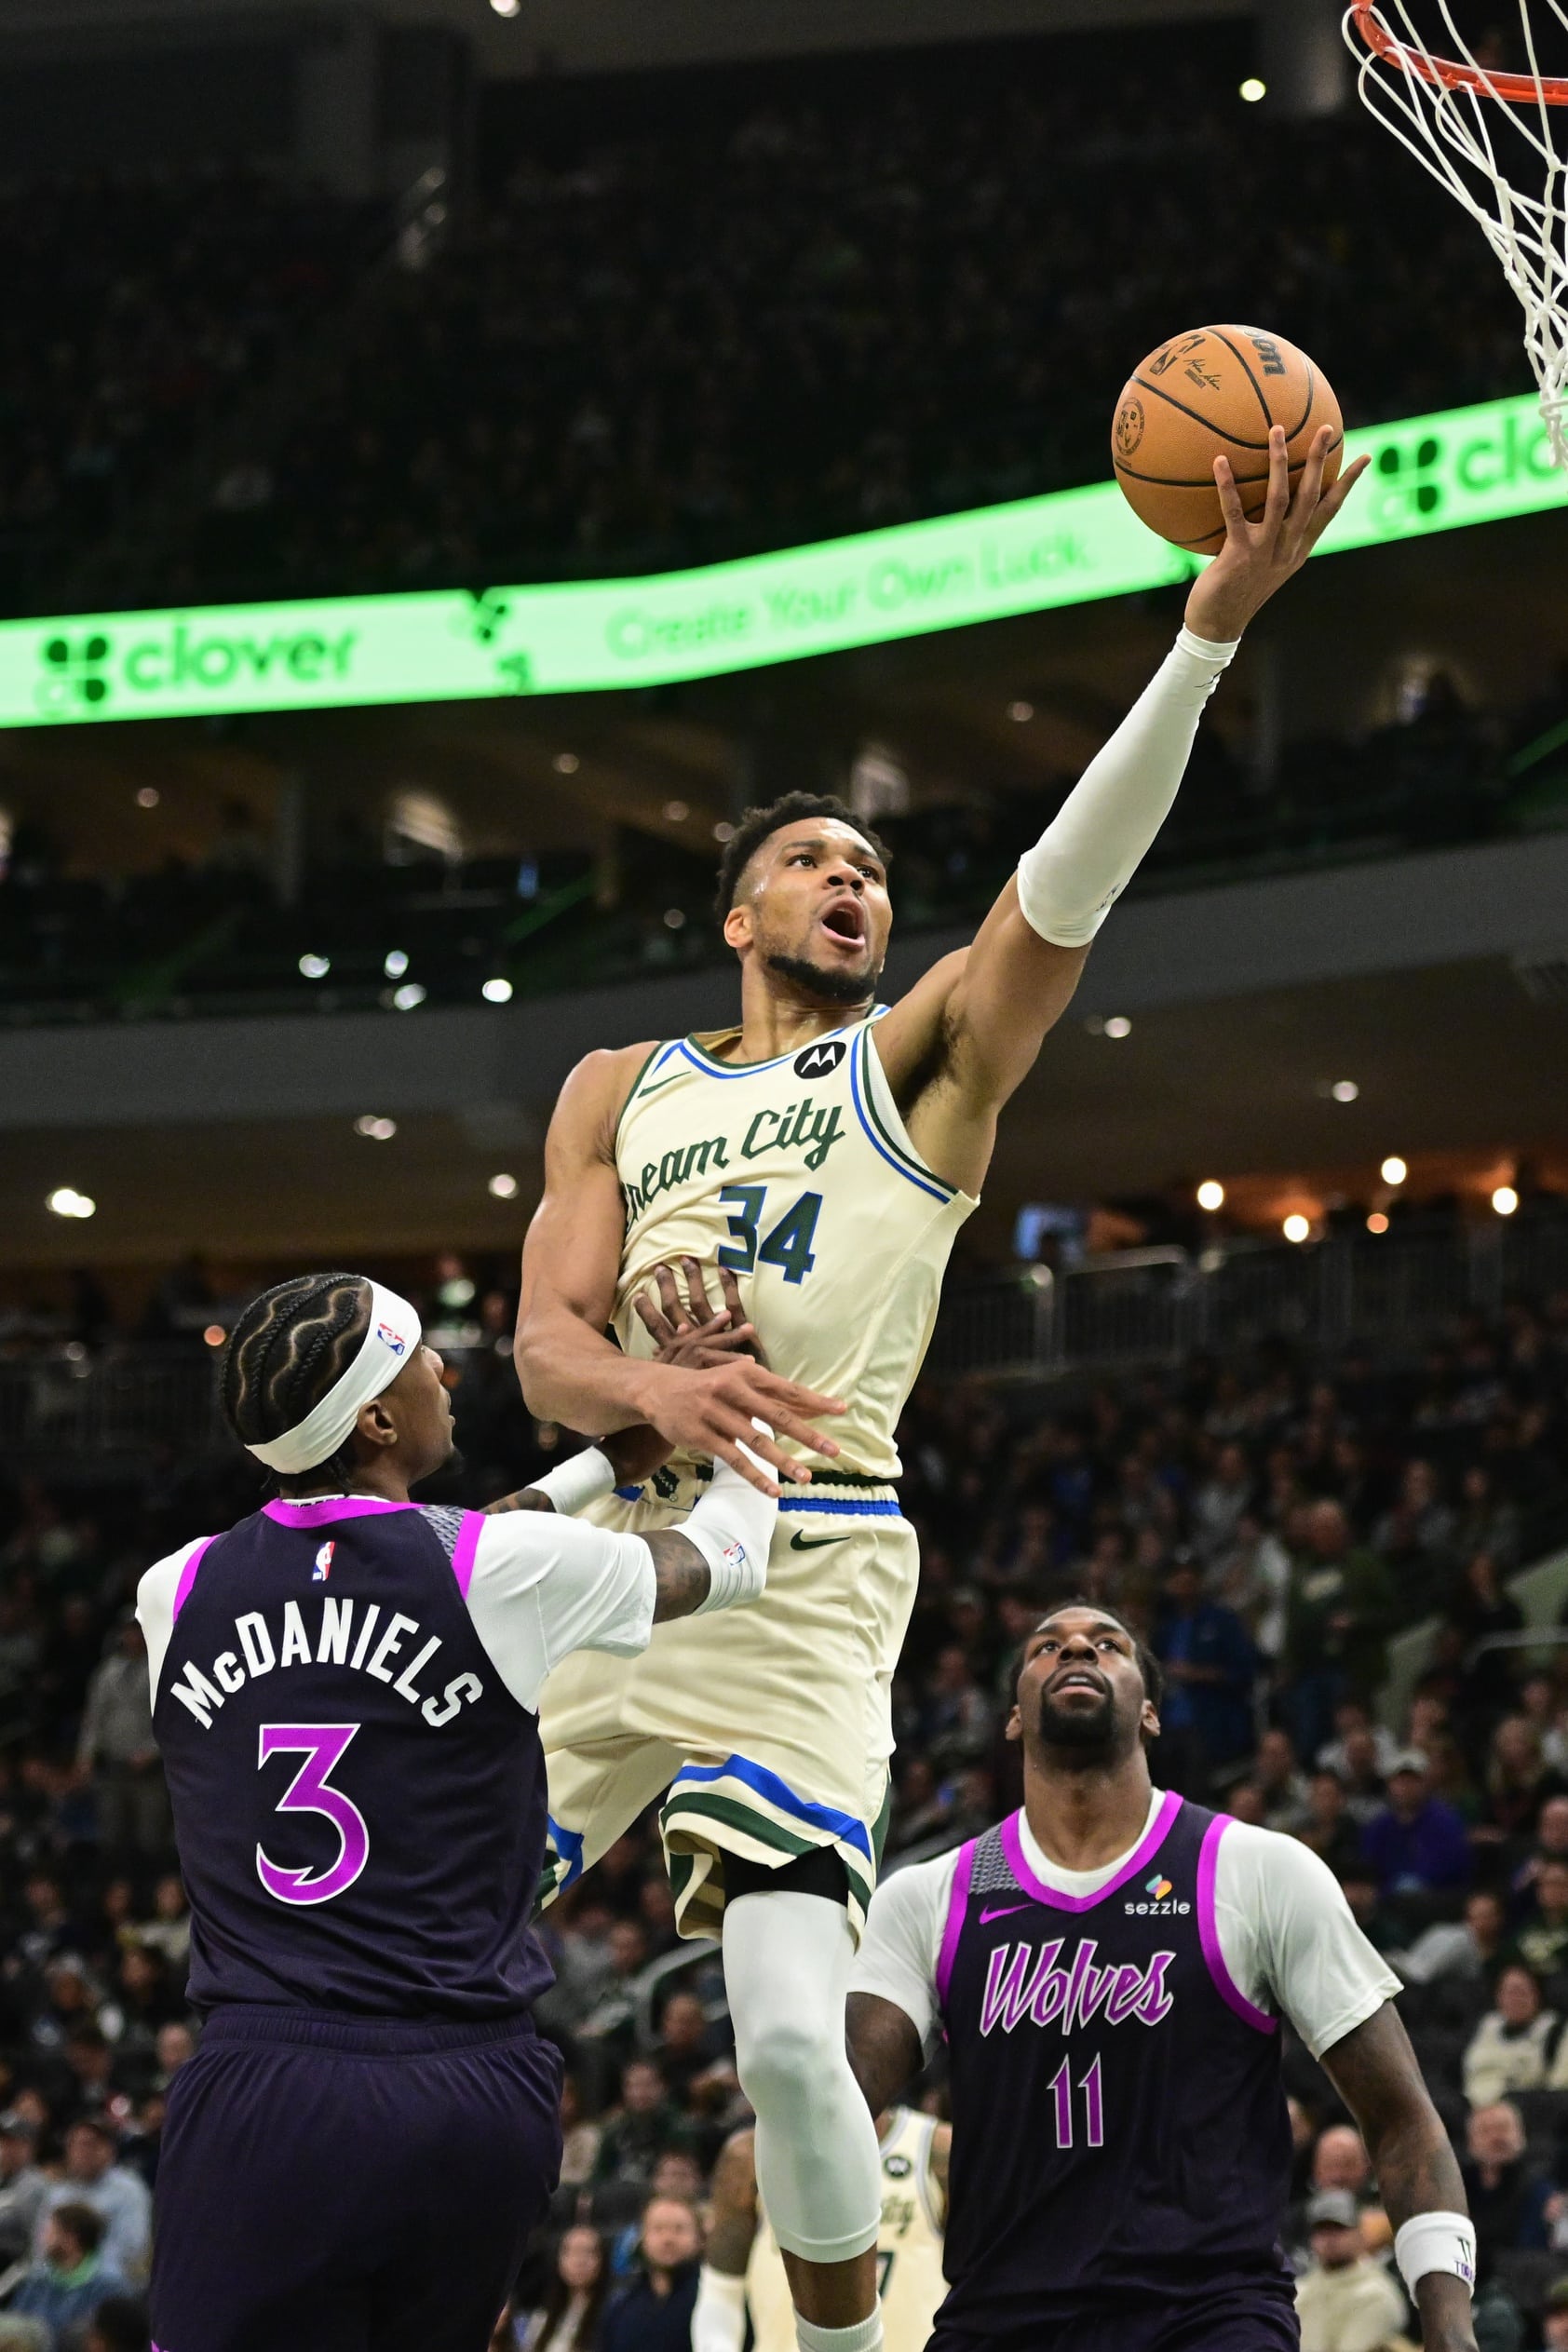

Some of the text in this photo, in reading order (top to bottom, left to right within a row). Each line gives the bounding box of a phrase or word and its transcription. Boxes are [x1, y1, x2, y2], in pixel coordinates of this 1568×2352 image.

[124, 624, 358, 692] clover
[624, 1096, 846, 1233] ream City
[717, 1184, 824, 1285] 34
[169, 1596, 484, 1730] McDANIELS
[256, 1723, 370, 1906] 3
[1124, 1899, 1191, 1916] sezzle
[979, 1937, 1177, 2038] Wolves
[1046, 2051, 1104, 2149] 11
